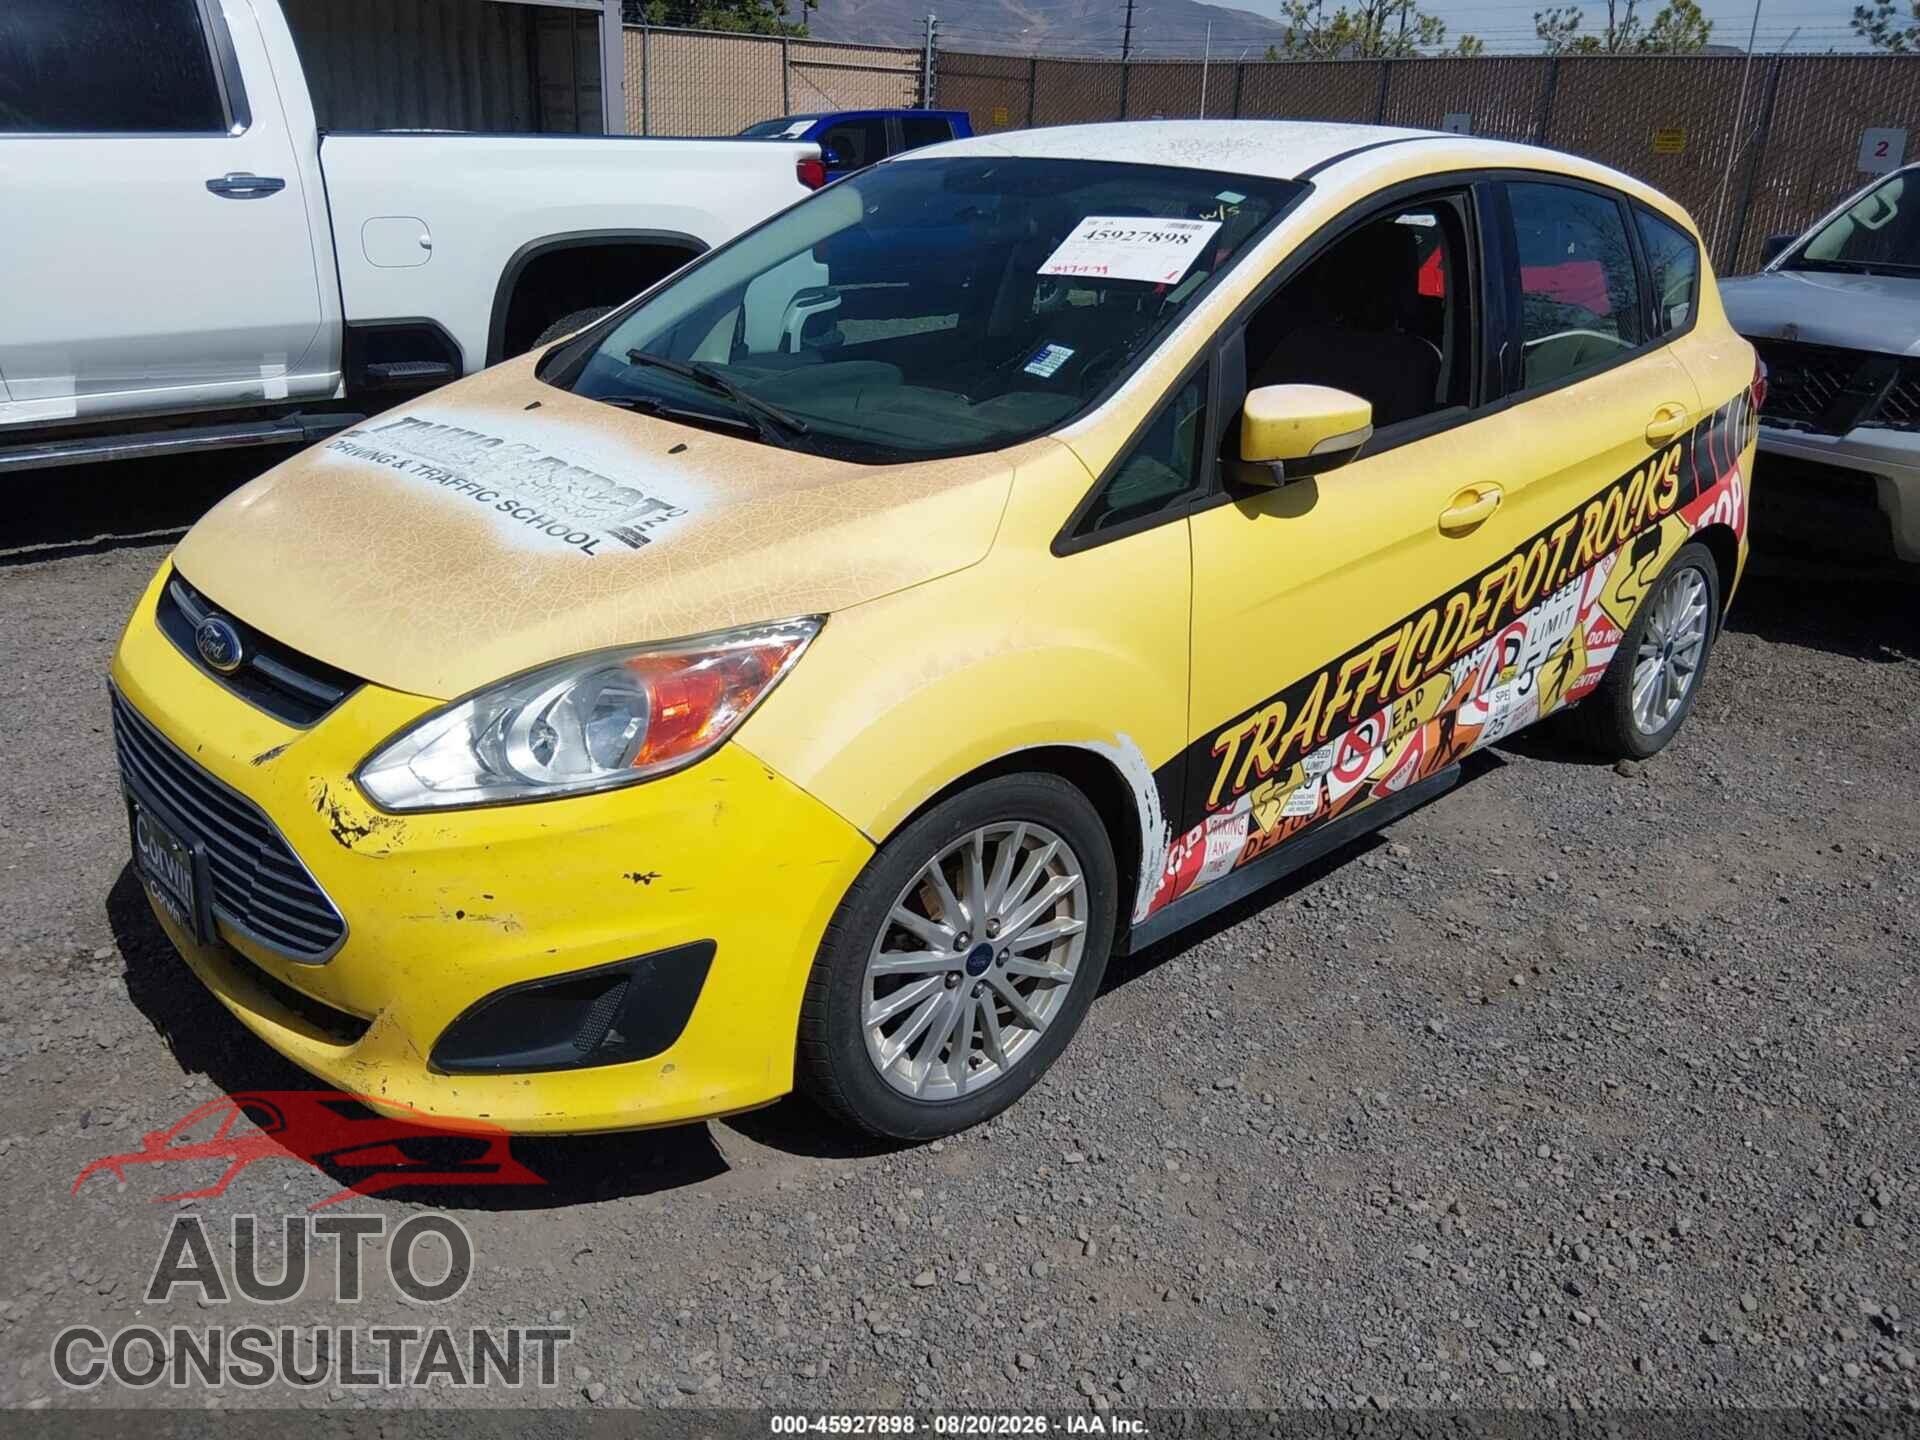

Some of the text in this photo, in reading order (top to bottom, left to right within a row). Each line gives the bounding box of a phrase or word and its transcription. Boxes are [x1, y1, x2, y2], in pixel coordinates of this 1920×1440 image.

[1874, 141, 1889, 157] 2
[1083, 228, 1193, 245] 45927898
[325, 440, 398, 465] DRIVING
[391, 456, 410, 470] &
[408, 464, 501, 503] TRAFFIC
[495, 498, 605, 556] SCHOOL
[1688, 471, 1741, 537] TOP
[200, 624, 226, 659] Ford
[1206, 442, 1682, 811] TRAFFICDEPOT.ROCKS
[1530, 605, 1574, 647] LIMIT
[1587, 630, 1604, 645] DO
[136, 814, 194, 902] Corwin
[151, 879, 182, 928] Corwin
